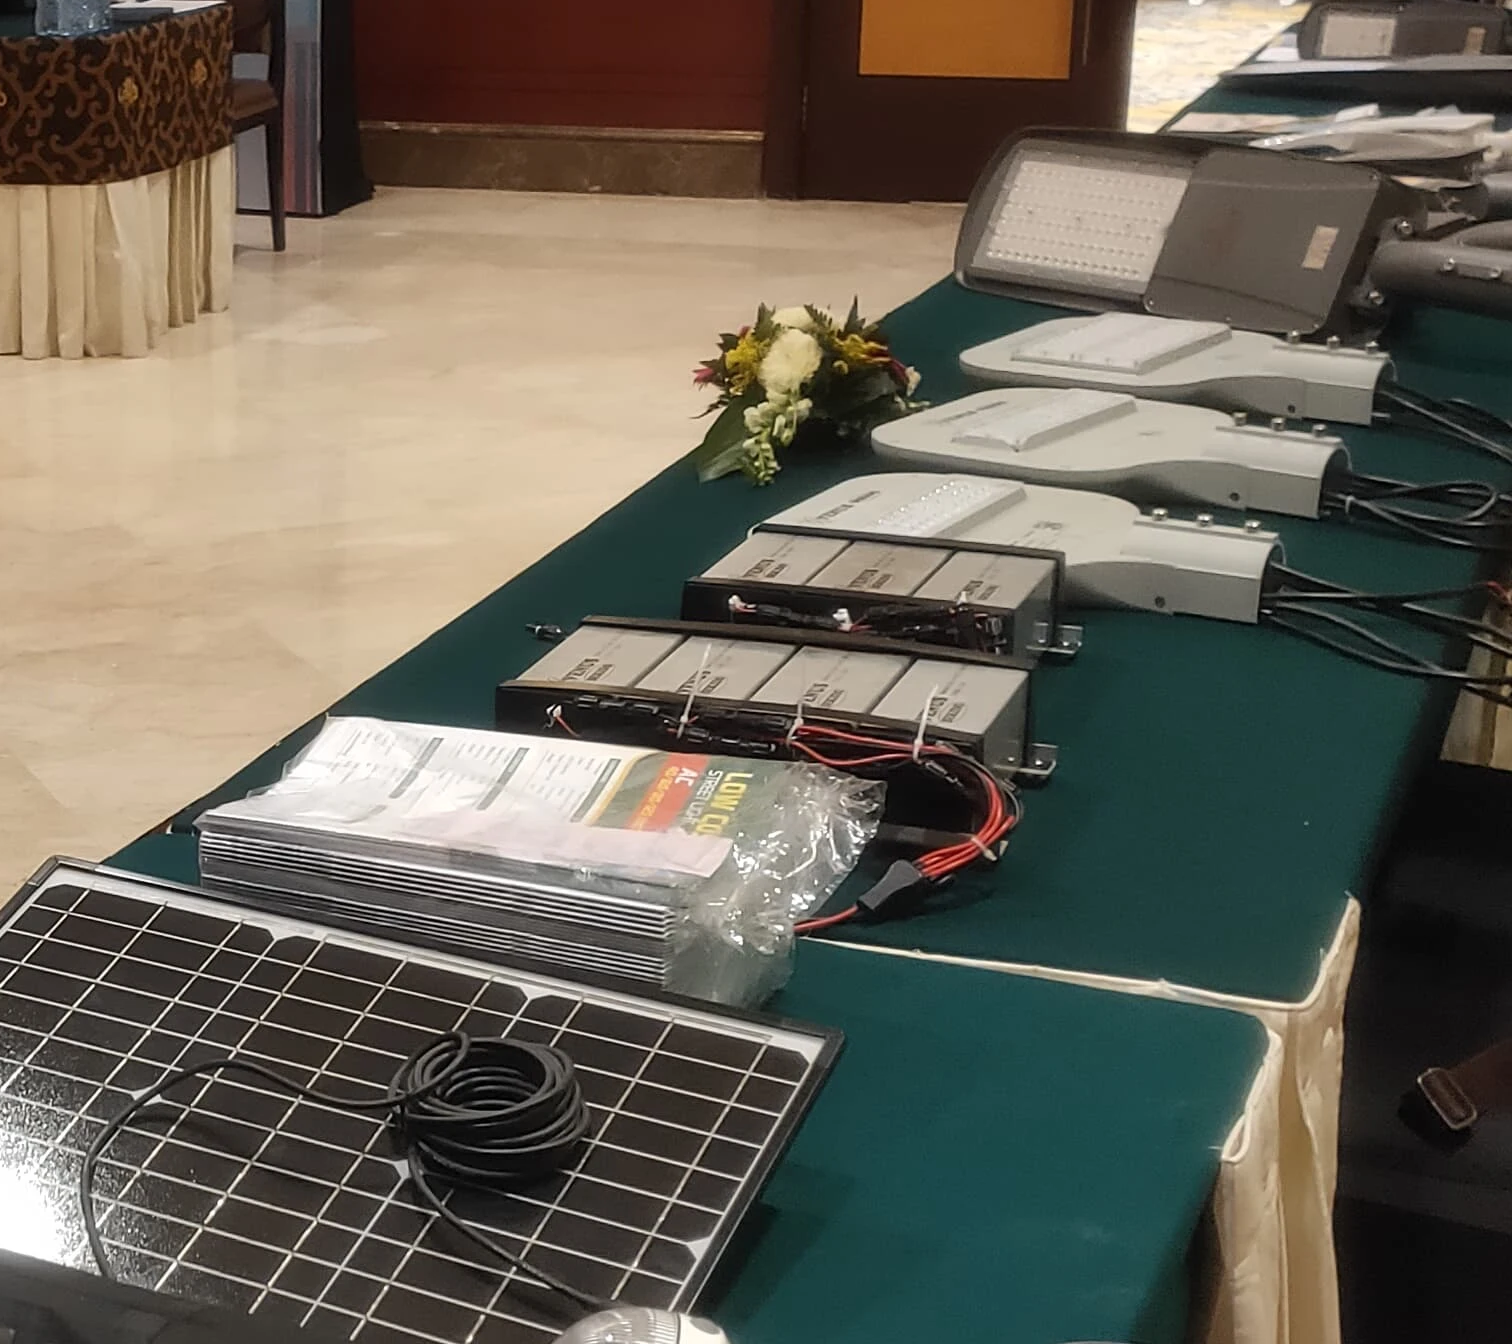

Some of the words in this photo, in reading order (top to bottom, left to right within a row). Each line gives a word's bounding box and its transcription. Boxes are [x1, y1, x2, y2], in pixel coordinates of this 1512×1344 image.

[674, 767, 699, 787] AC
[695, 769, 723, 801] STREET
[710, 772, 753, 811] LOW
[695, 813, 729, 836] CO
